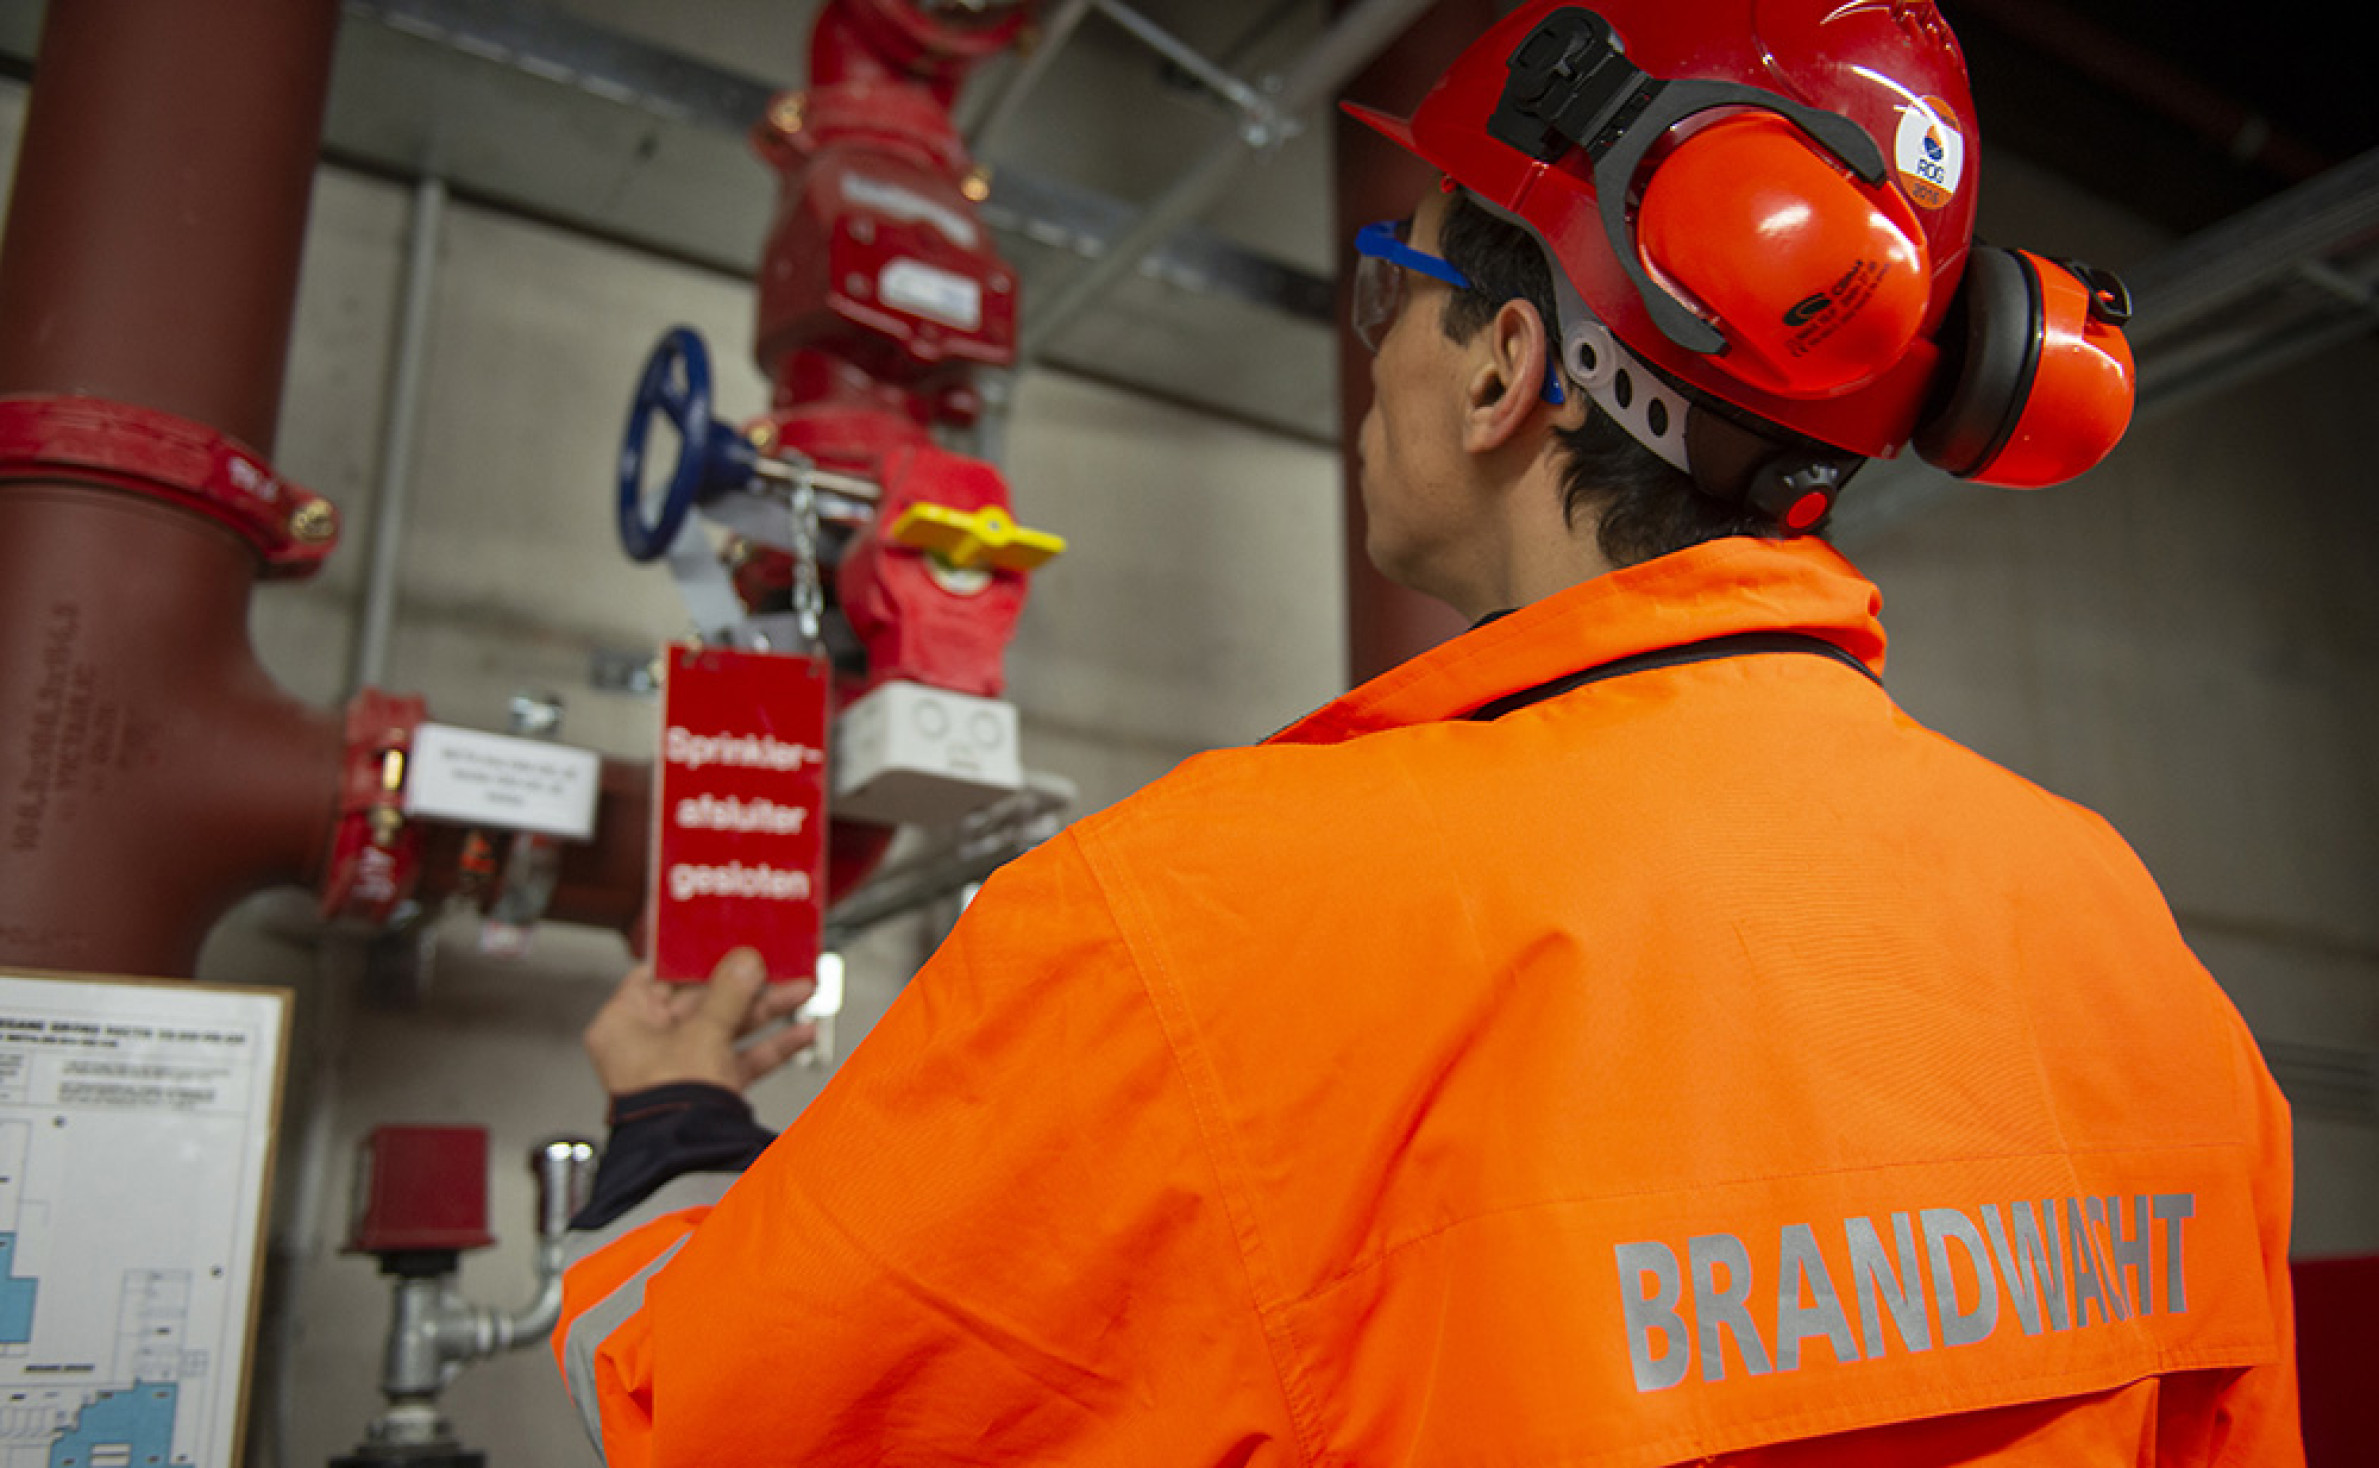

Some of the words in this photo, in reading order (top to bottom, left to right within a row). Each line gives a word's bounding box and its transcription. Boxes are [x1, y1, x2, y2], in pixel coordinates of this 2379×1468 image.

[666, 727, 825, 771] Sprinkler-
[675, 793, 808, 835] afsluiter
[669, 860, 811, 901] gesloten
[1614, 1193, 2196, 1393] BRANDWACHT
